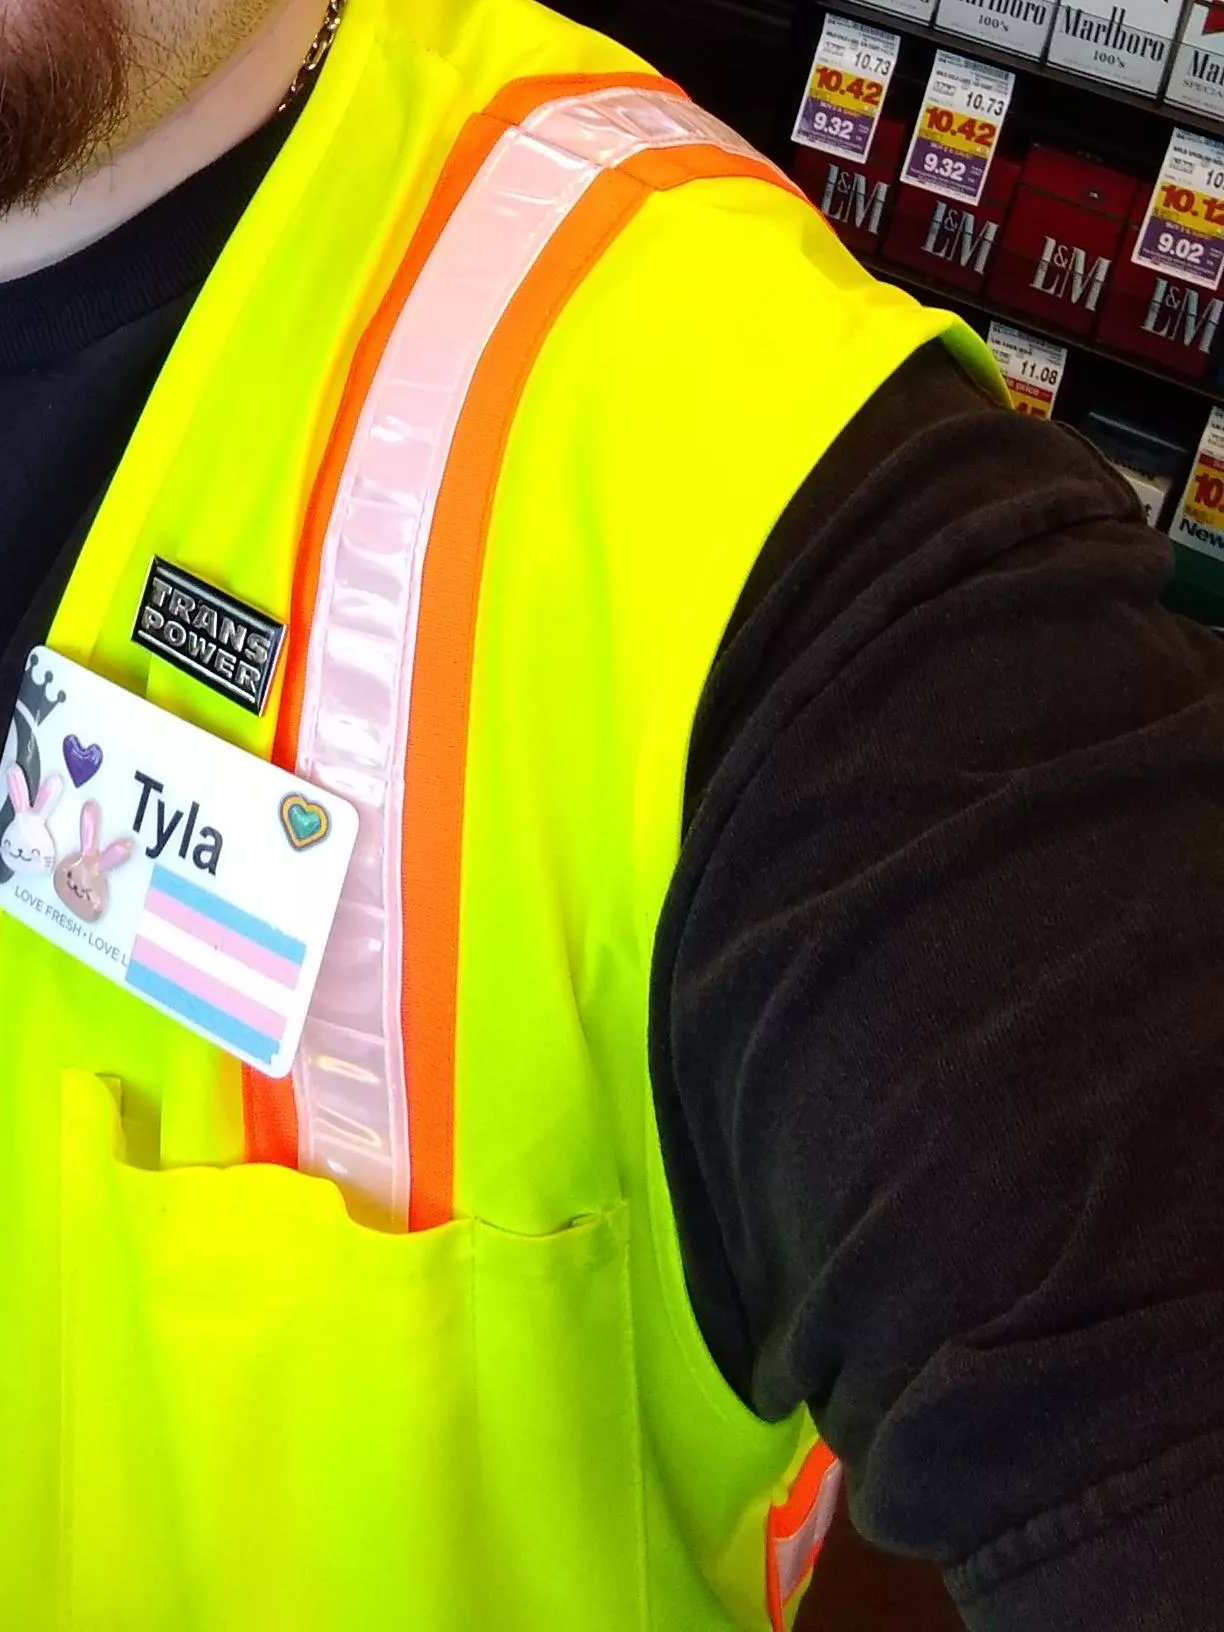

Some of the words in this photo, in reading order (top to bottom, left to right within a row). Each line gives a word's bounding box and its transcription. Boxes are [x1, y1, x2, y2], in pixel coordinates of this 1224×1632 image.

[978, 14, 1010, 33] 100's
[1059, 6, 1165, 63] Marlboro
[853, 50, 892, 76] 10.73
[1092, 50, 1127, 70] 100's
[815, 65, 883, 106] 10.42
[965, 90, 1006, 117] 10.73
[813, 112, 854, 140] 9.32
[925, 106, 997, 147] 10.42
[923, 153, 966, 182] 9.32
[821, 163, 891, 235] L&M
[921, 200, 1000, 276] L&M
[1157, 232, 1204, 267] 9.02
[1029, 235, 1112, 312] L&M
[1141, 276, 1224, 354] L&M
[1020, 360, 1059, 386] 11.08
[148, 576, 273, 667] TRANS
[140, 604, 262, 693] POWER
[130, 769, 225, 877] Tyla
[14, 884, 43, 913] LOVE
[44, 905, 83, 937] FRESH
[88, 932, 121, 962] LOVE
